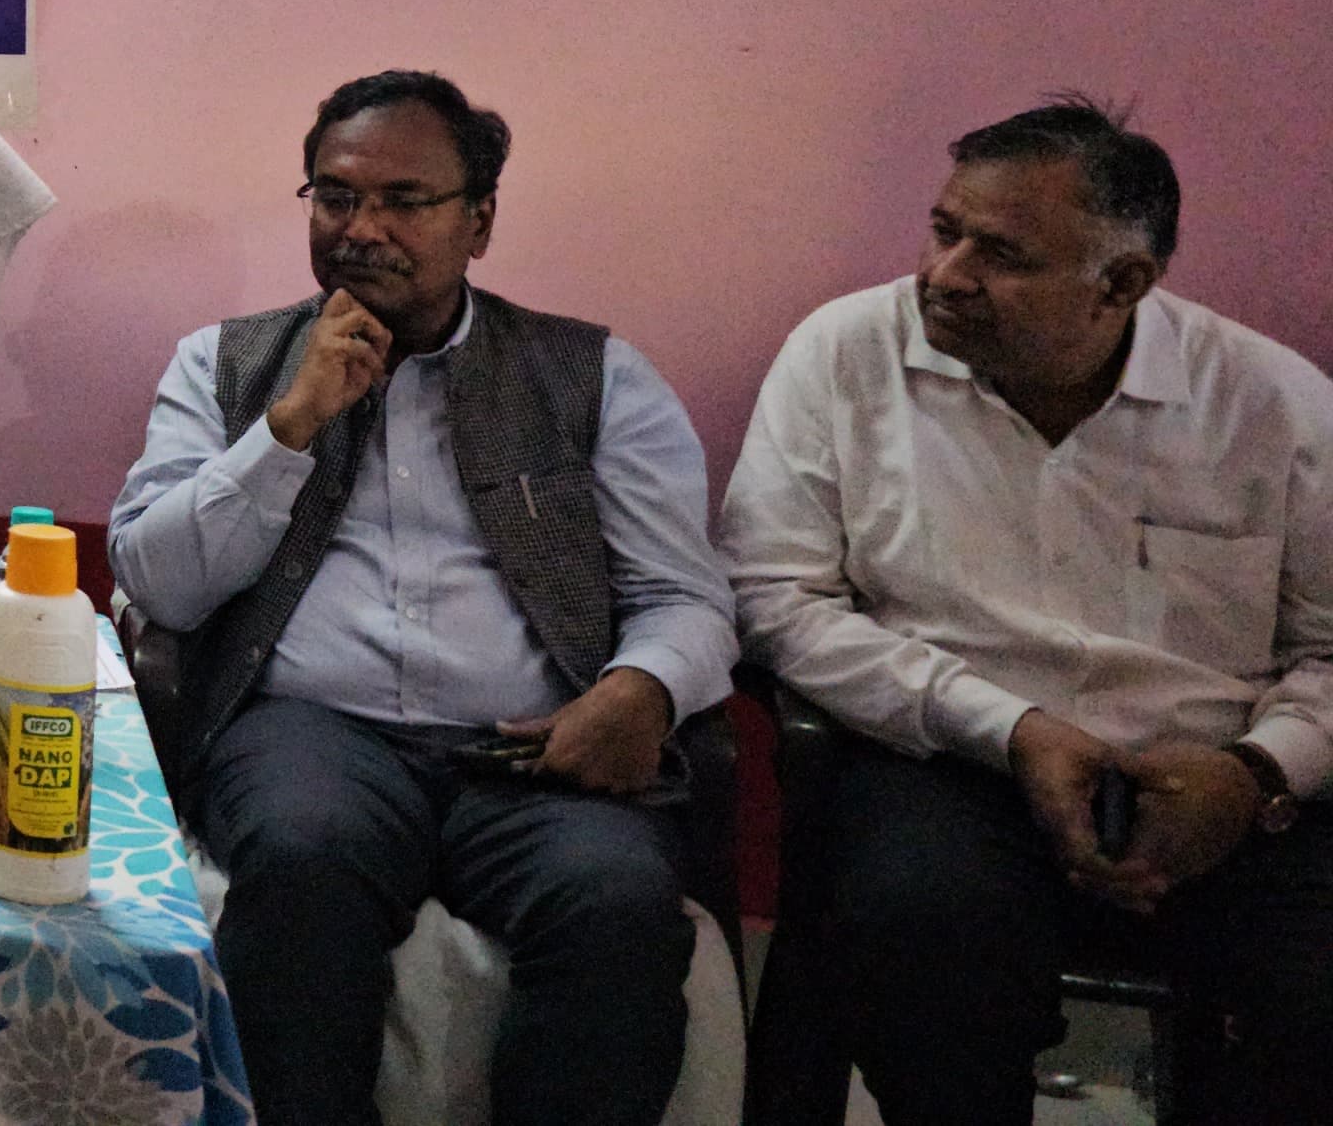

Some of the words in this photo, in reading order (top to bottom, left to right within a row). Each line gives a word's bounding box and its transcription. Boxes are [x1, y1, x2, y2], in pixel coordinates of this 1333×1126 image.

[30, 719, 67, 732] IFFCO
[19, 747, 73, 764] NANO
[20, 766, 71, 787] DAP
